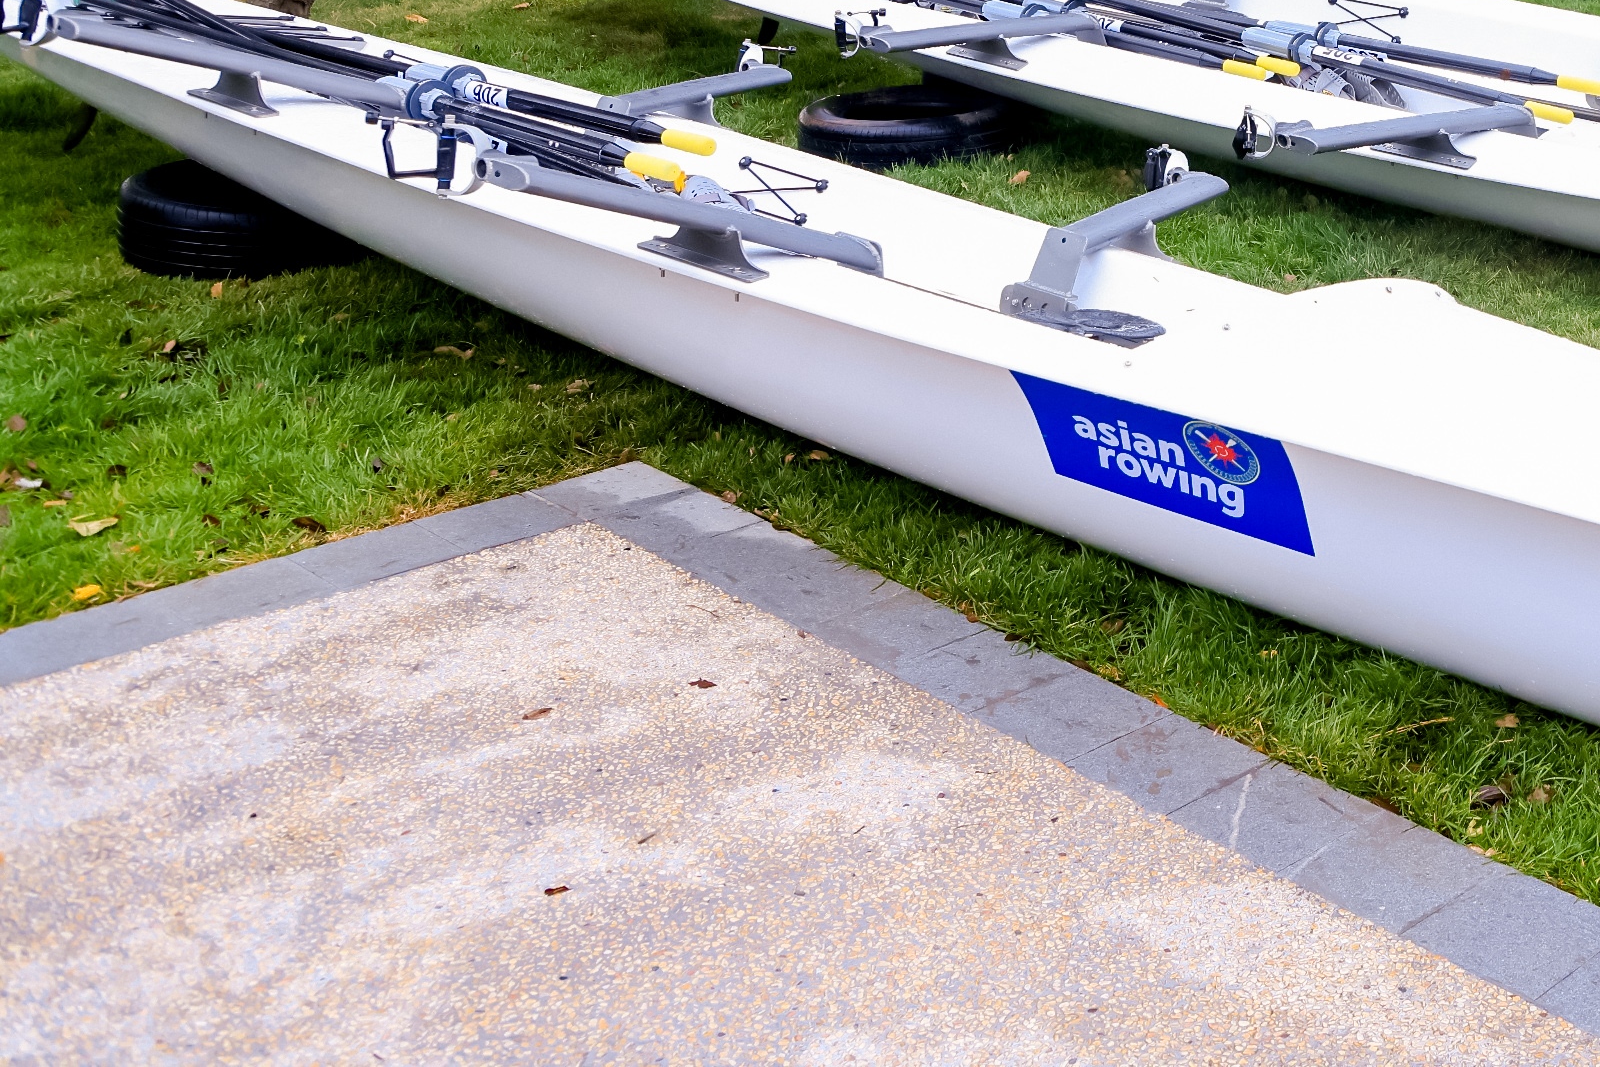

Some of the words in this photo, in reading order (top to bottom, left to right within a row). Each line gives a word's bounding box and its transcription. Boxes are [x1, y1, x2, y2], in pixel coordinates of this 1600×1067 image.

[472, 84, 502, 106] 206
[1071, 415, 1185, 467] asian
[1097, 446, 1245, 518] rowing
